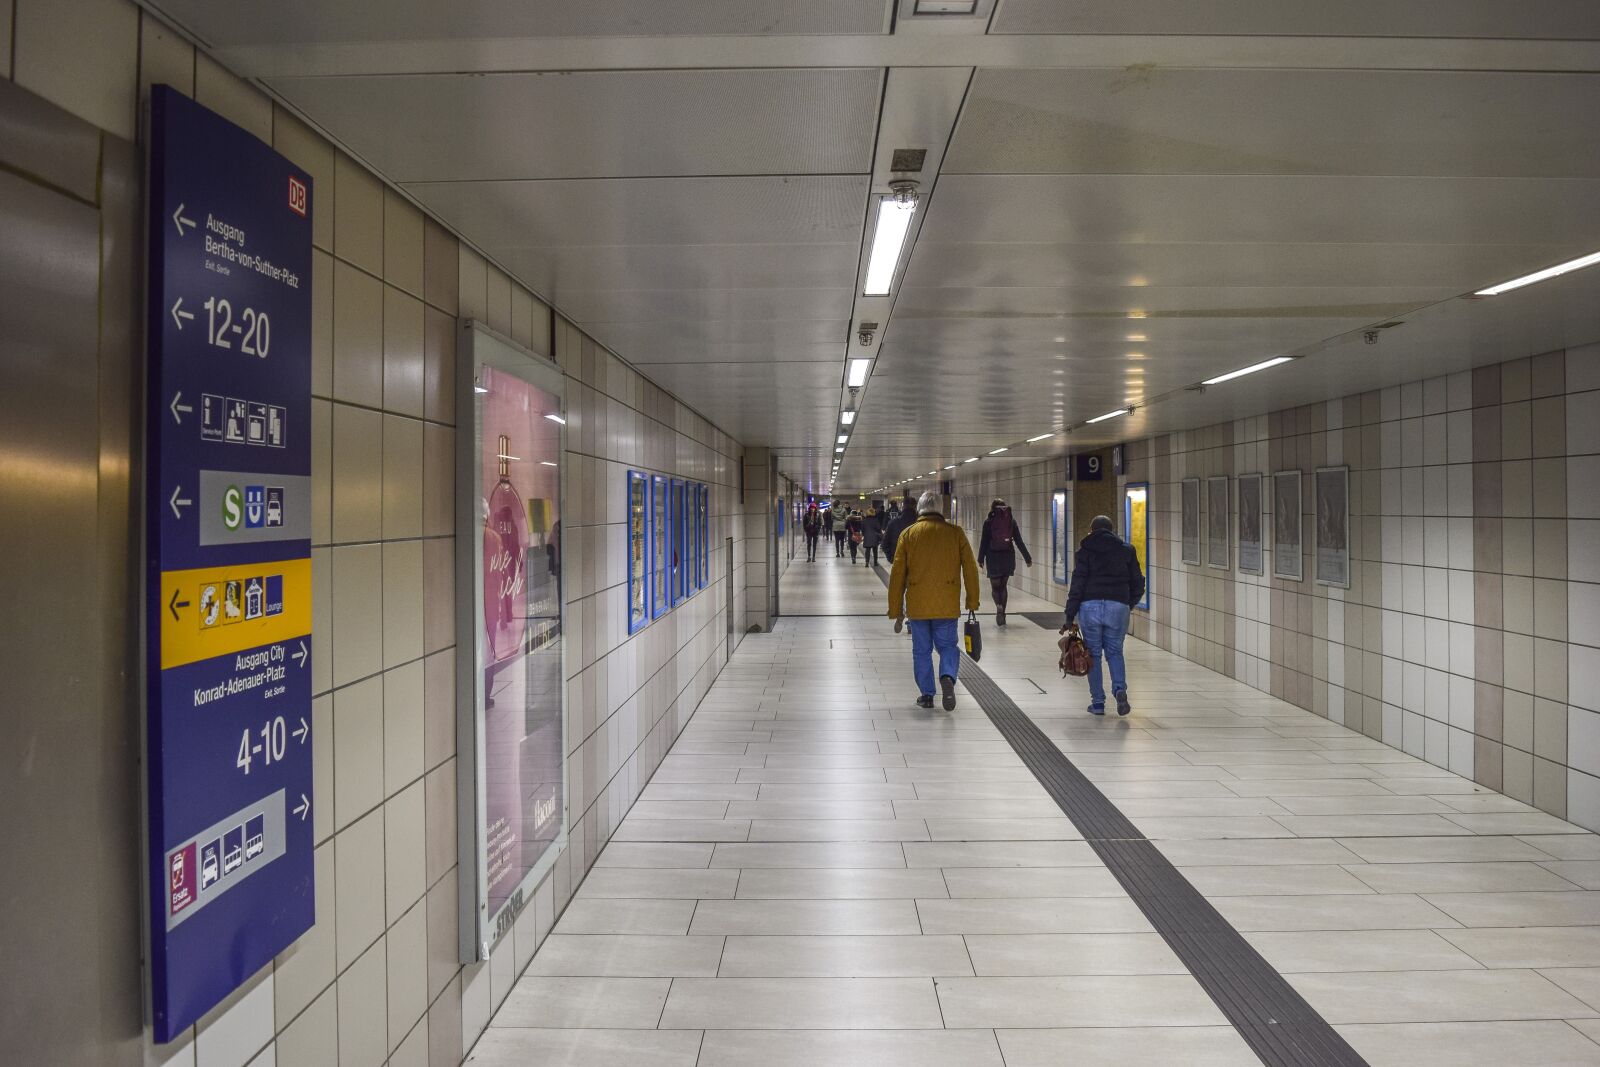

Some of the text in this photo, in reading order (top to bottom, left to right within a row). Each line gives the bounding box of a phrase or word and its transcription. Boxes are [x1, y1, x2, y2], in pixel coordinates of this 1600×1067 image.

[290, 179, 306, 214] DB
[206, 213, 245, 247] Ausgang
[205, 235, 299, 288] Bertha-von-Suttner-Platz
[204, 296, 270, 358] 12-20
[1088, 456, 1099, 473] 9
[266, 602, 282, 612] Lounge
[235, 645, 285, 671] Ausgang City
[194, 667, 285, 707] Konrad-Adenauer-Platz
[237, 715, 286, 775] 4-10
